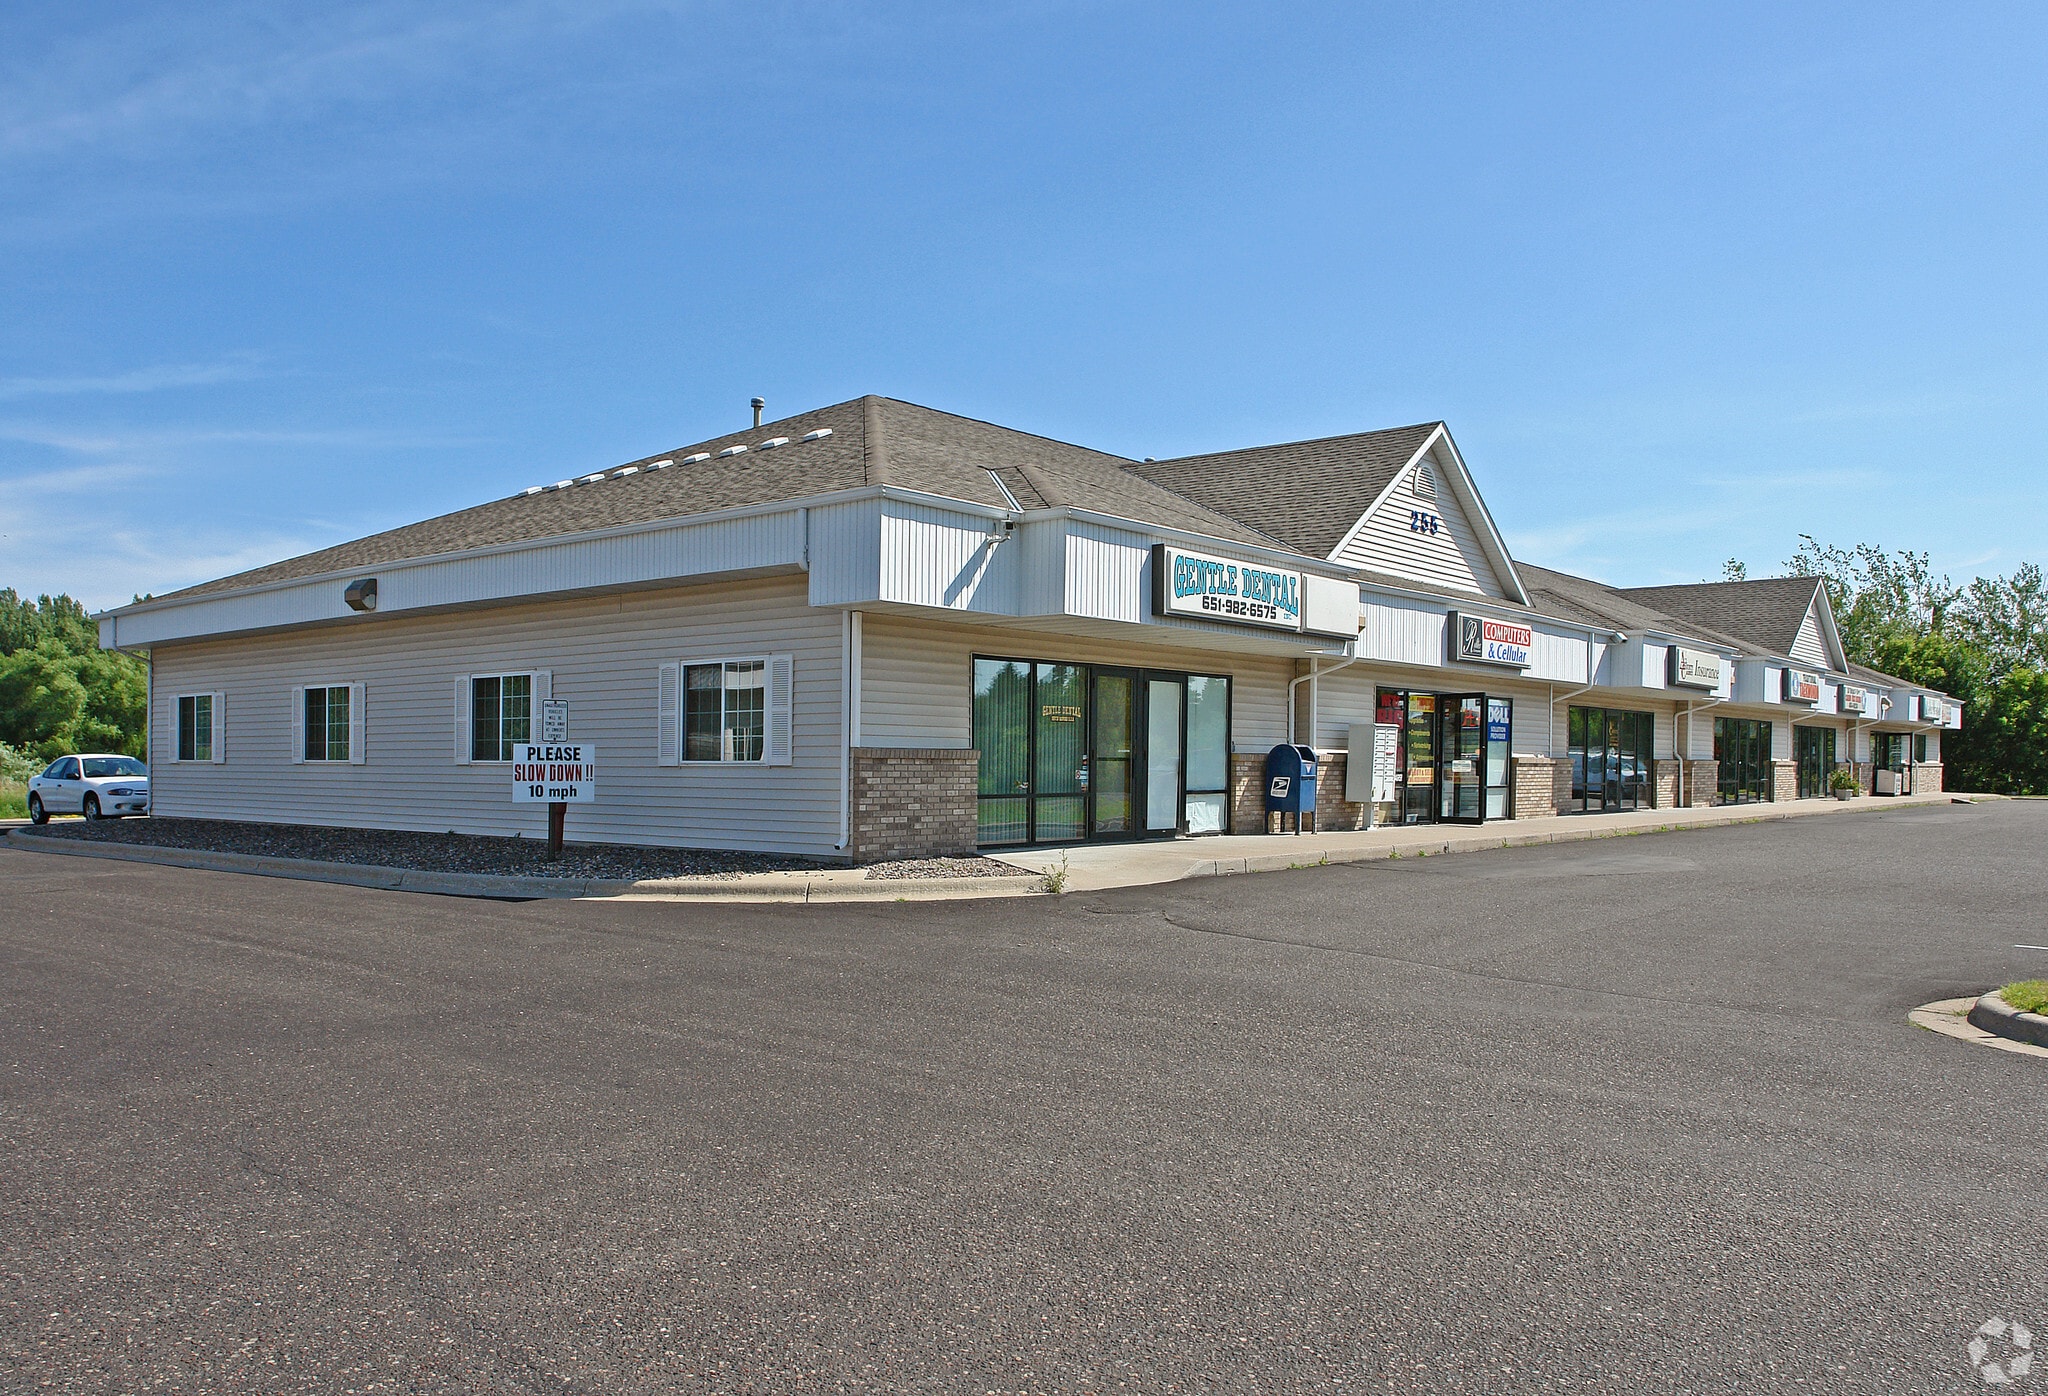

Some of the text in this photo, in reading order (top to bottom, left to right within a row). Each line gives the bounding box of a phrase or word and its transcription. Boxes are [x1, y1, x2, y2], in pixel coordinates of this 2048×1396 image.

[1411, 510, 1438, 535] 255
[1174, 554, 1299, 617] GENTLE DENTAL
[1485, 623, 1530, 645] COMPUTERS
[1488, 643, 1527, 663] & Cellular
[1488, 706, 1510, 724] DELL
[527, 746, 581, 761] PLEASE
[514, 764, 593, 781] SLOW DOWN !!
[528, 785, 577, 800] 10 mph
